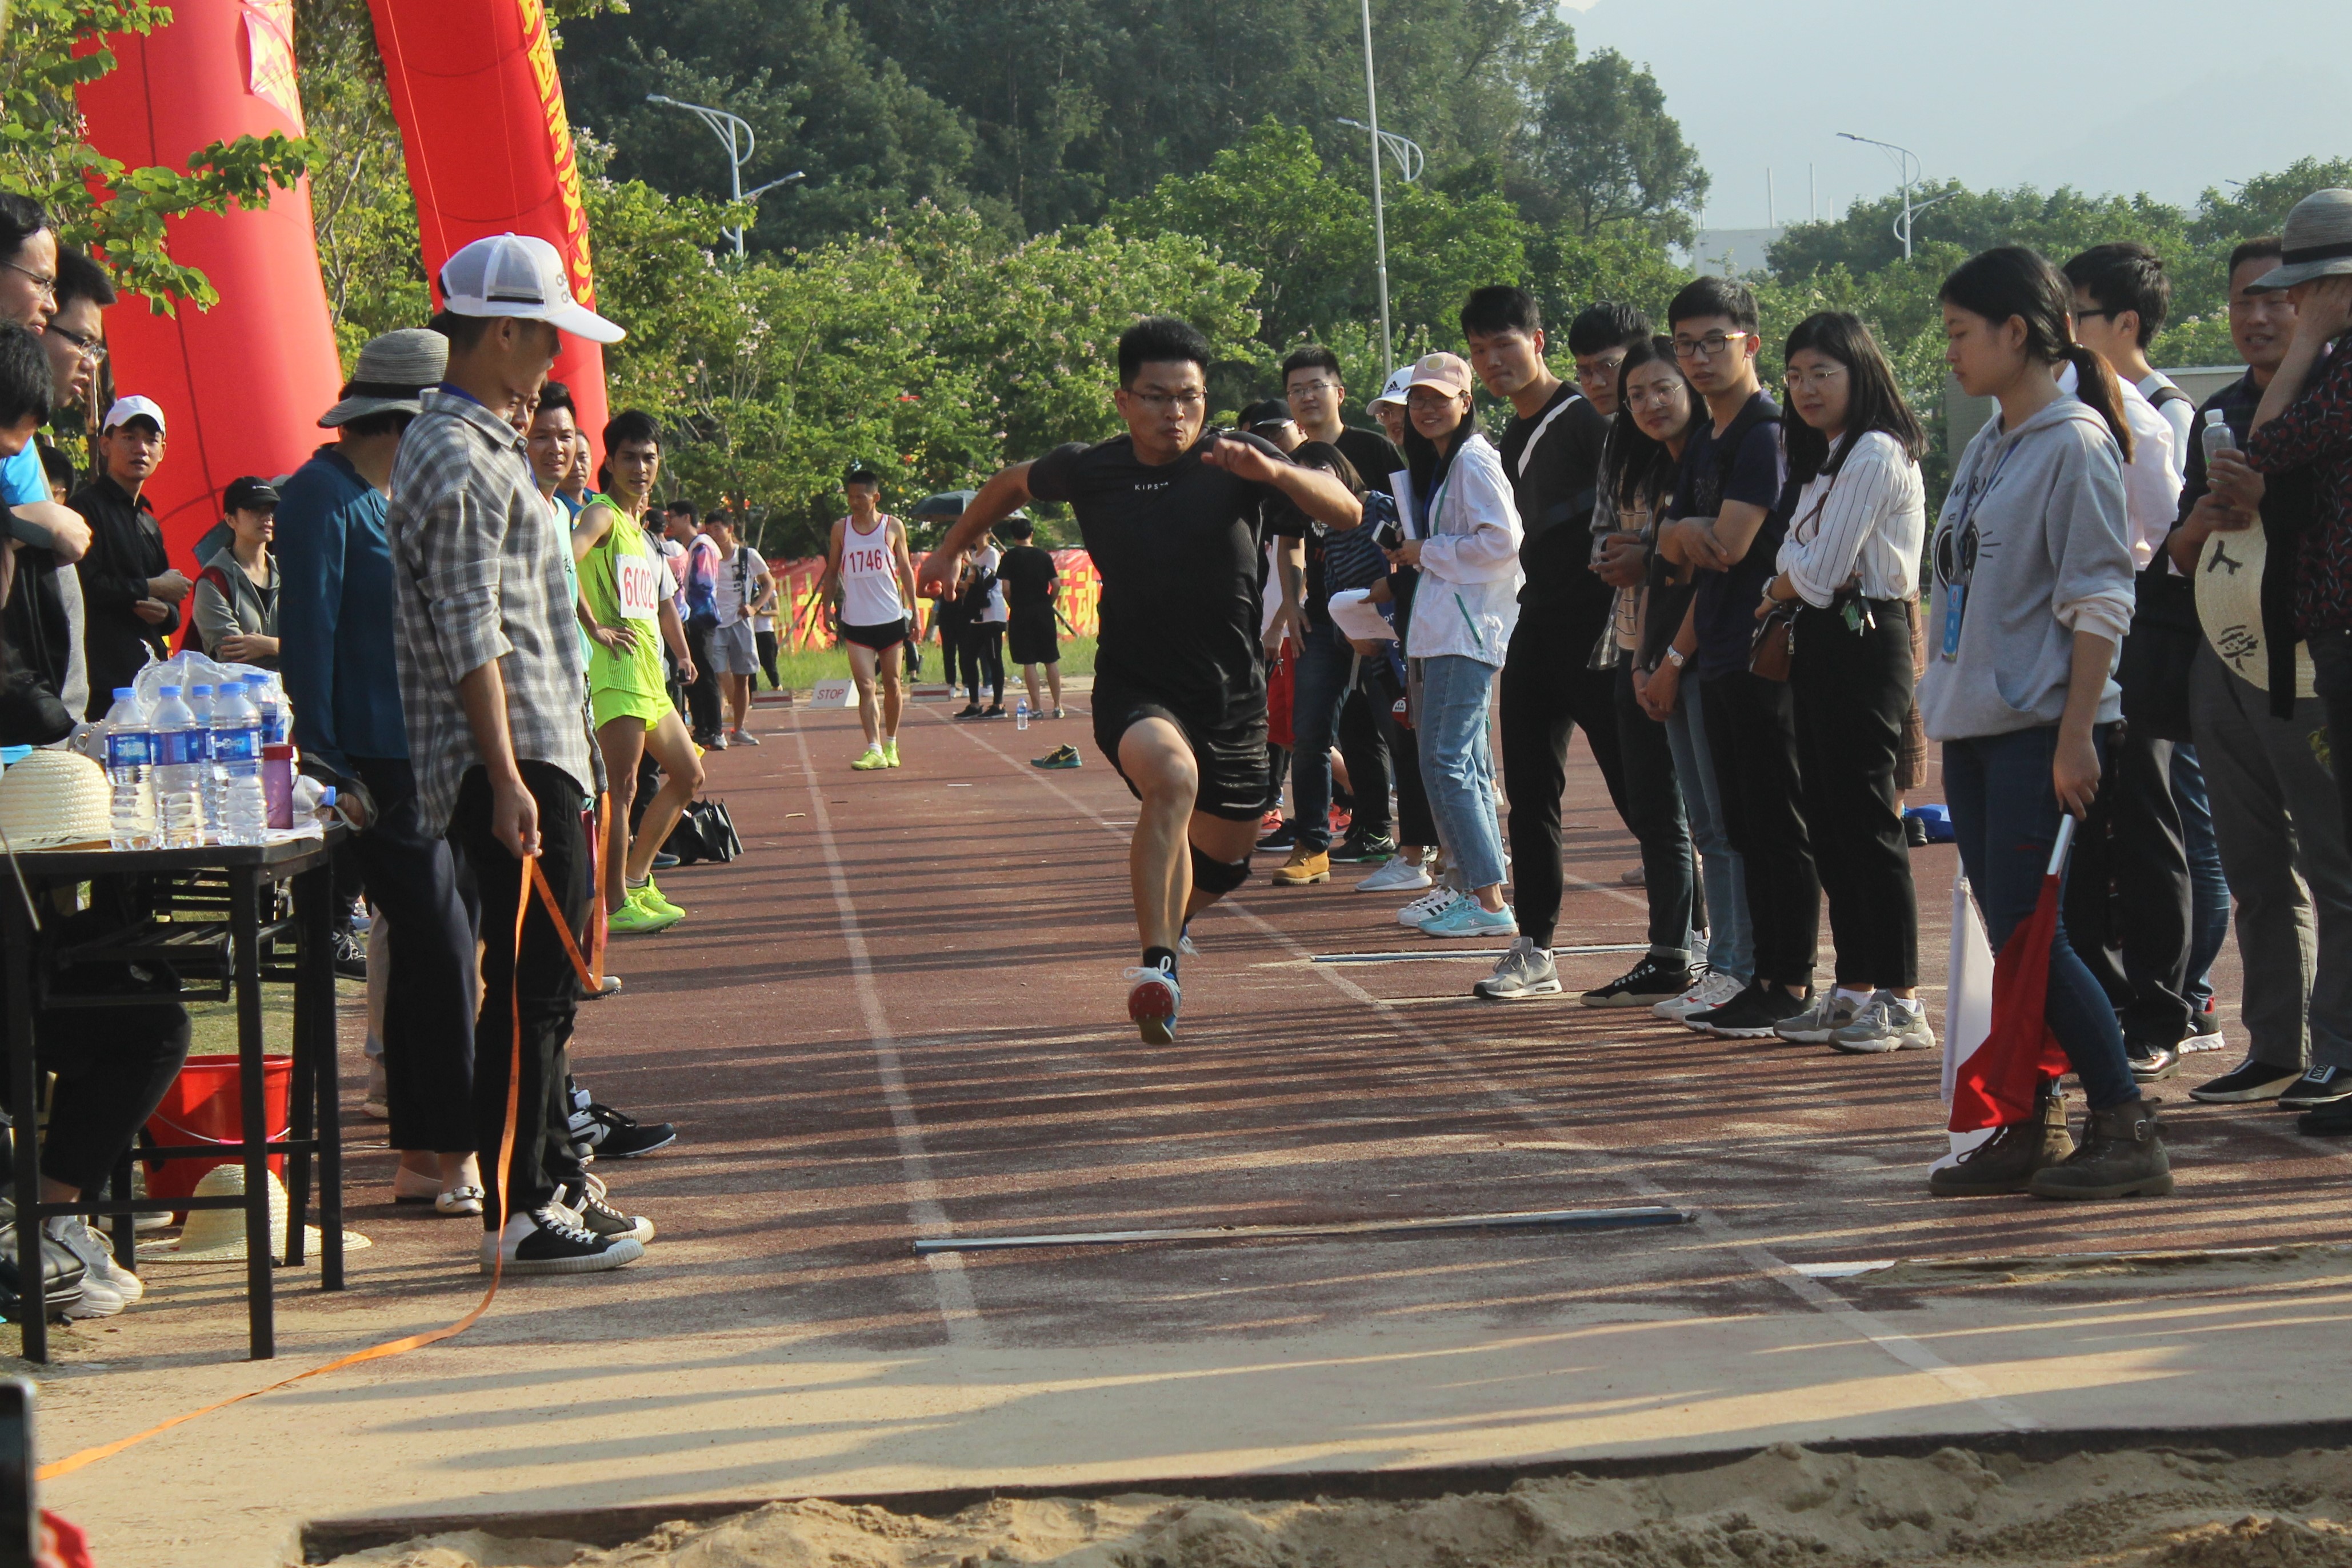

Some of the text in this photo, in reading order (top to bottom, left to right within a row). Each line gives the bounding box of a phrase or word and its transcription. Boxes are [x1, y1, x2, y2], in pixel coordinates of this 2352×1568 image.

[1134, 481, 1169, 491] KIPSA
[850, 549, 882, 573] 1746
[623, 566, 655, 609] 6002
[817, 688, 845, 700] STOP
